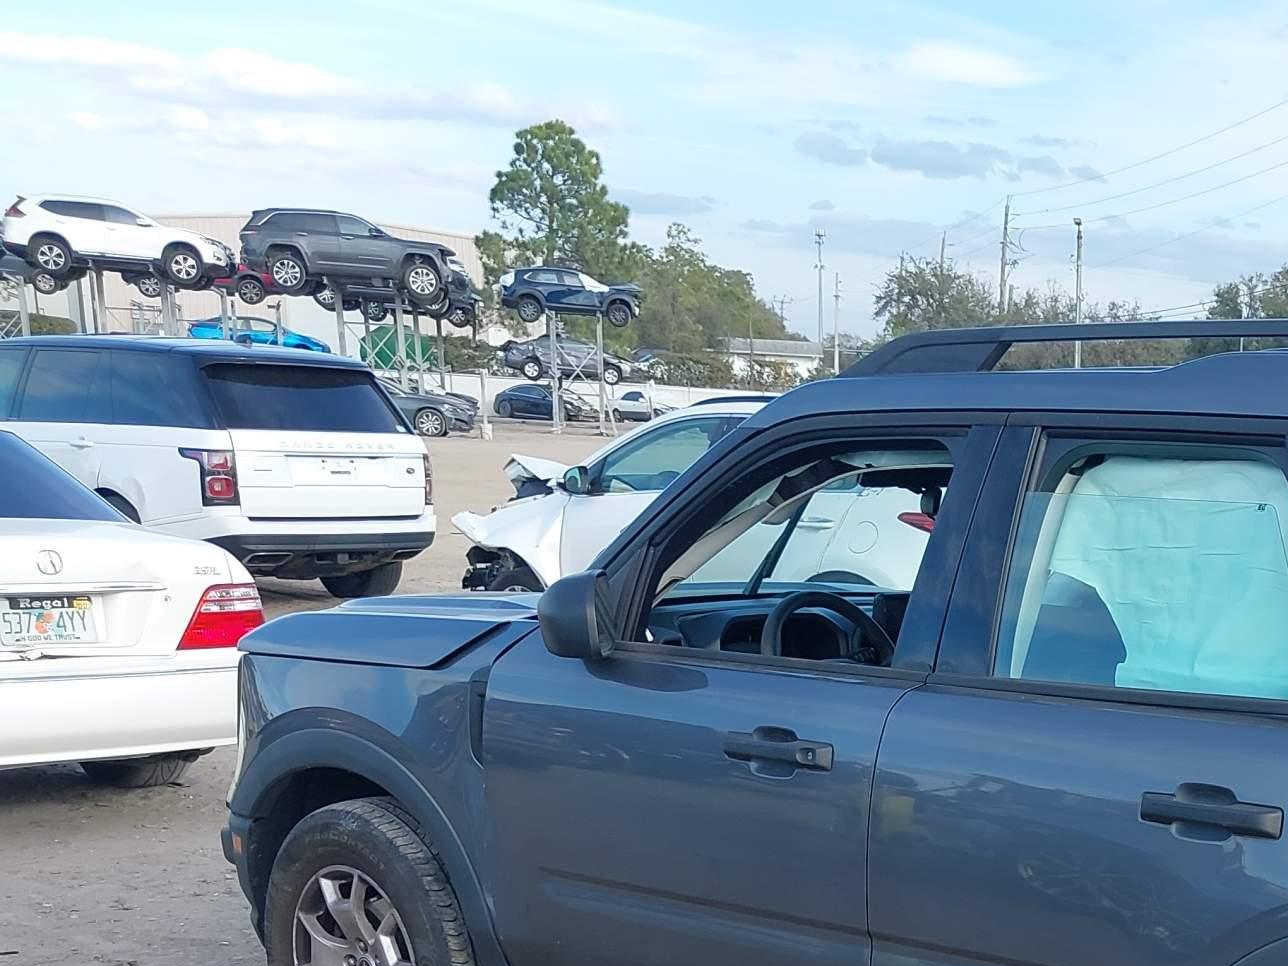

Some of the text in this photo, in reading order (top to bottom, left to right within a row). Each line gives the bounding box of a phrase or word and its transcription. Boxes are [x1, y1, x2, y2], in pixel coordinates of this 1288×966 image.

[345, 442, 395, 450] ROVER
[17, 597, 69, 610] Regal
[2, 612, 33, 634] 537
